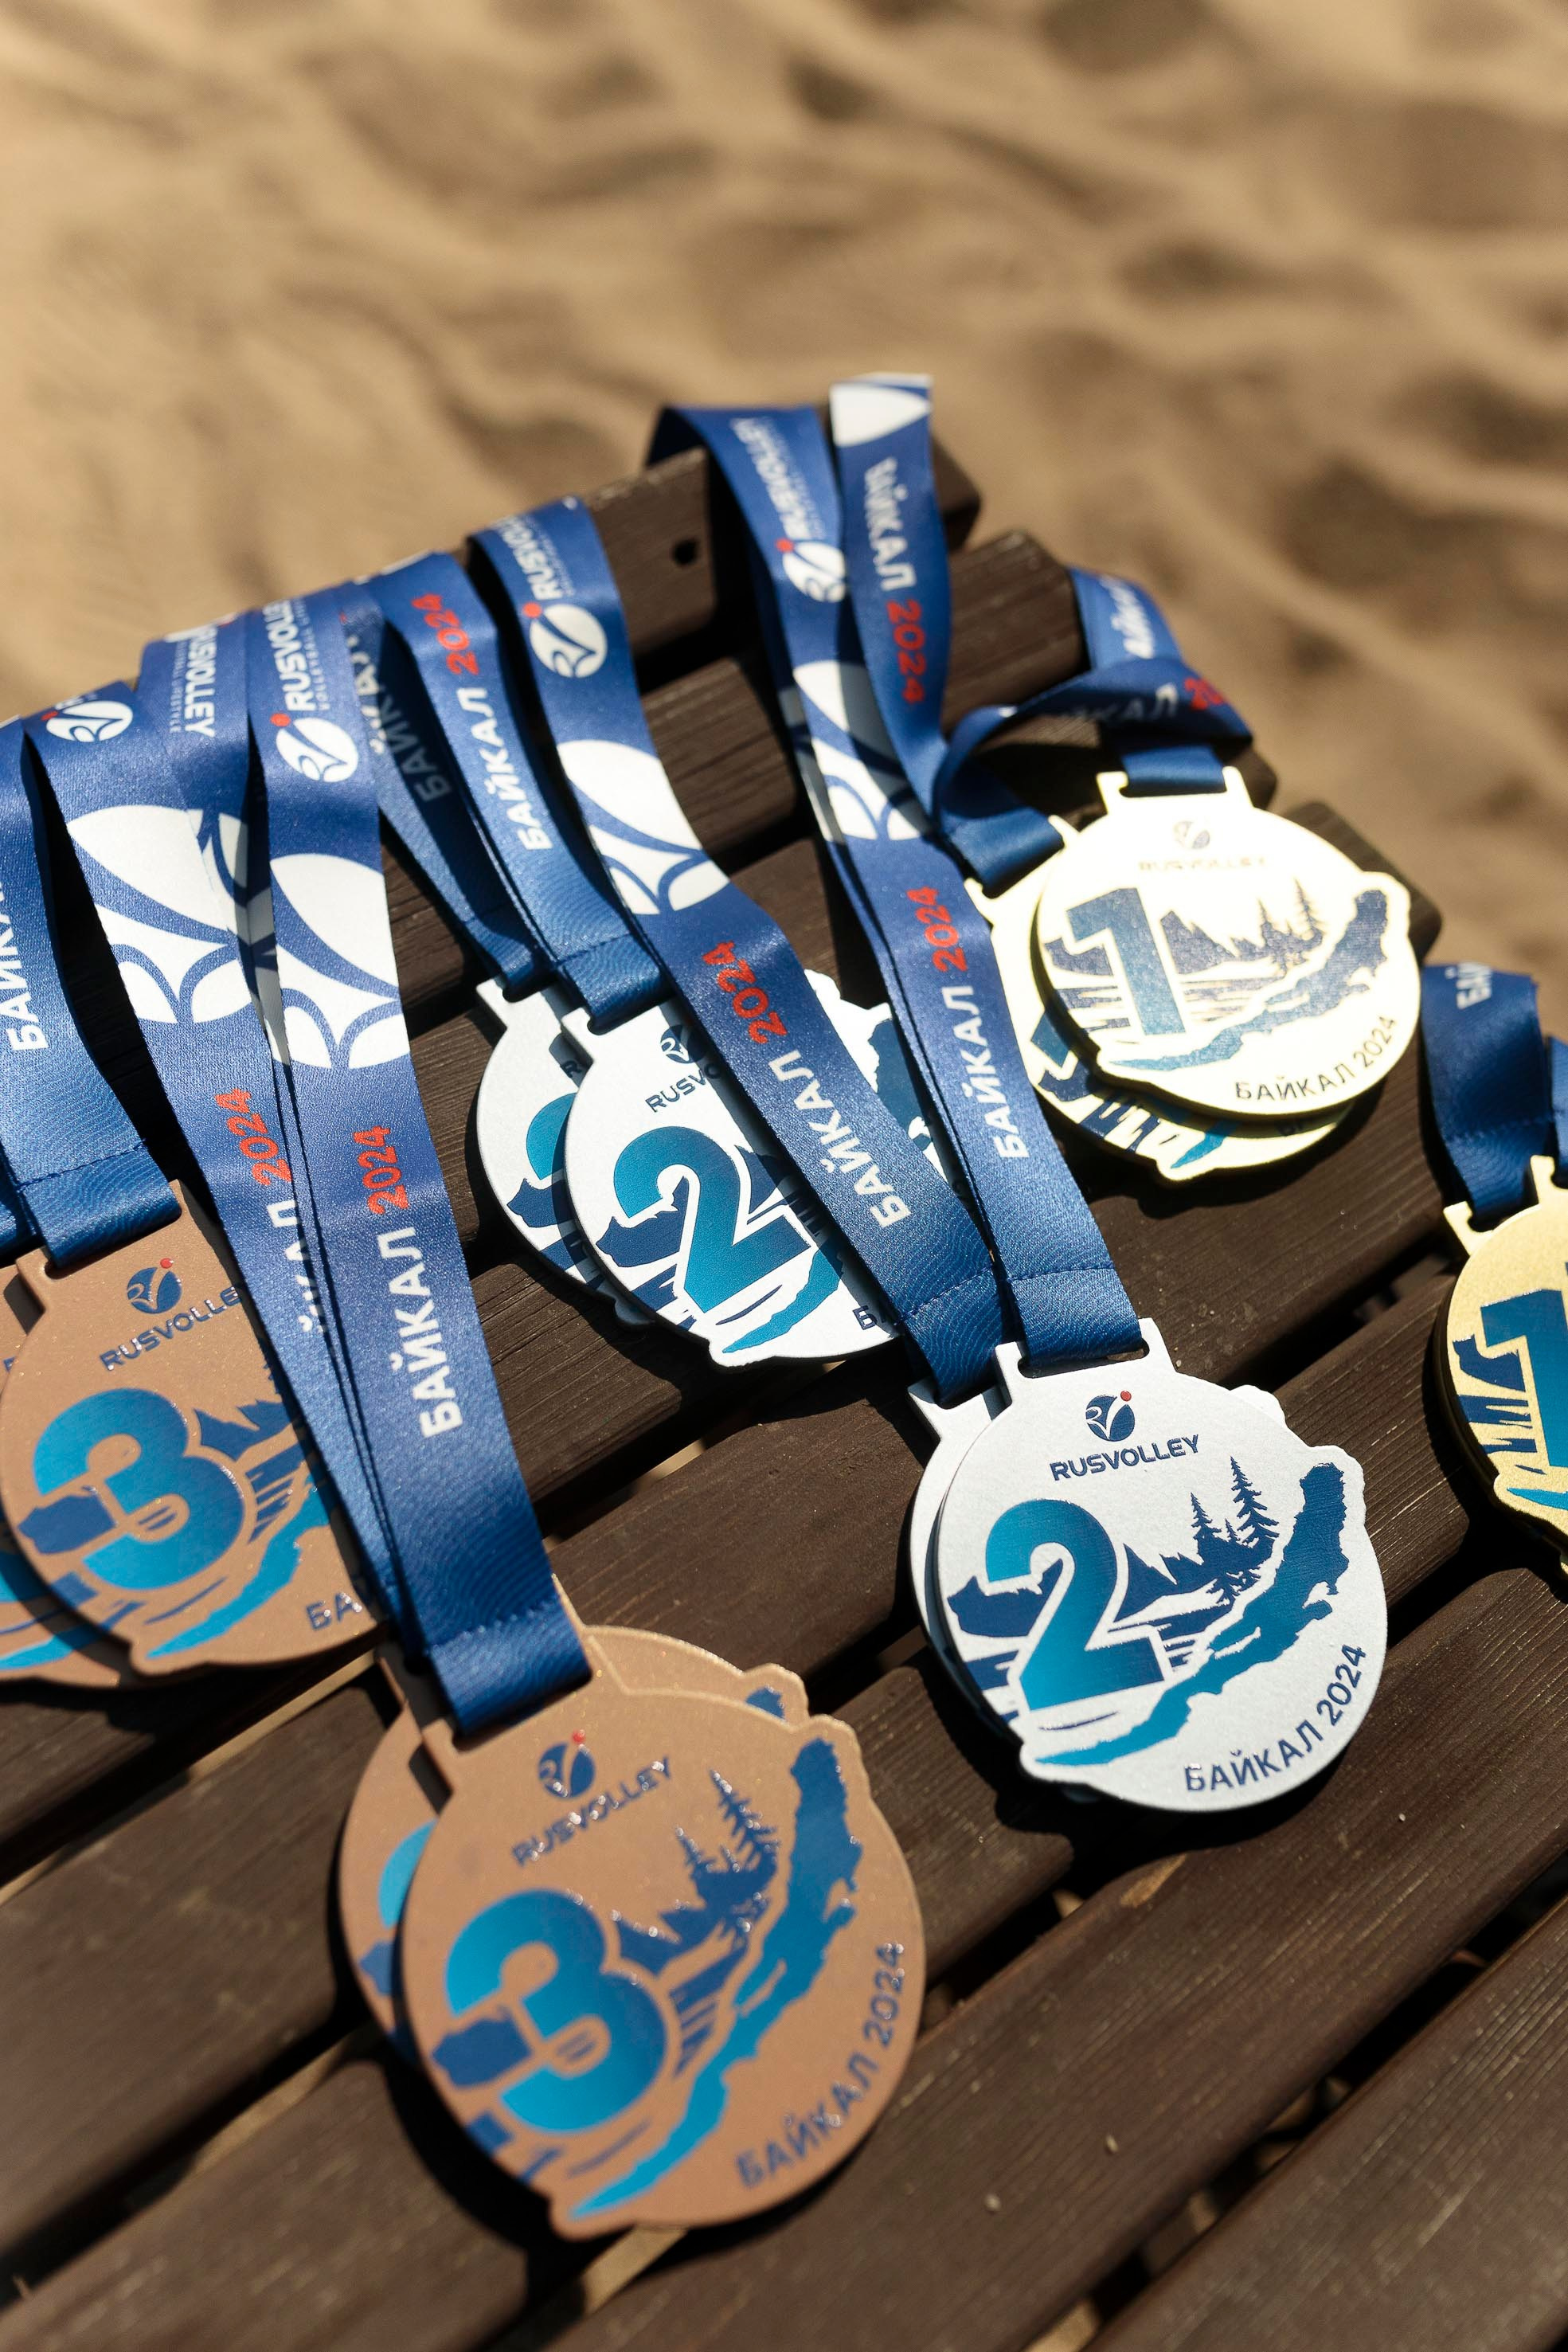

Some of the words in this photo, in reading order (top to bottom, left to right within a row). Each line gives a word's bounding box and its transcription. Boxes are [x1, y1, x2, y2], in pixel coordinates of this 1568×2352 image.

[410, 593, 480, 676] 2024
[886, 598, 926, 704] 2024
[456, 687, 553, 851] БАЙКАЛ
[702, 940, 788, 1046] 2024
[905, 886, 968, 972] 2024
[1066, 887, 1187, 1036] 1
[941, 984, 1030, 1159] БАЙКАЛ
[1235, 1063, 1355, 1101] БАЙКАЛ
[1353, 1016, 1396, 1068] 2024
[215, 1088, 293, 1186] 2024
[352, 1125, 409, 1215] 2024
[768, 1048, 913, 1227] БАЙКАЛ
[613, 1125, 811, 1313] 2
[99, 1286, 241, 1372] RUSVOLLE
[377, 1227, 464, 1438] БАЙКАЛ
[32, 1387, 246, 1591] 3
[1049, 1433, 1201, 1481] RUSVOLLEY
[985, 1498, 1166, 1712] 2
[1183, 1719, 1325, 1794] БАЙКАЛ
[1316, 1644, 1367, 1728] 2024
[511, 1755, 672, 1868] RUSVOLLEY
[444, 1886, 671, 2135] 3
[736, 2051, 880, 2189] БАЙКАЛ
[863, 1942, 905, 2049] 2024
